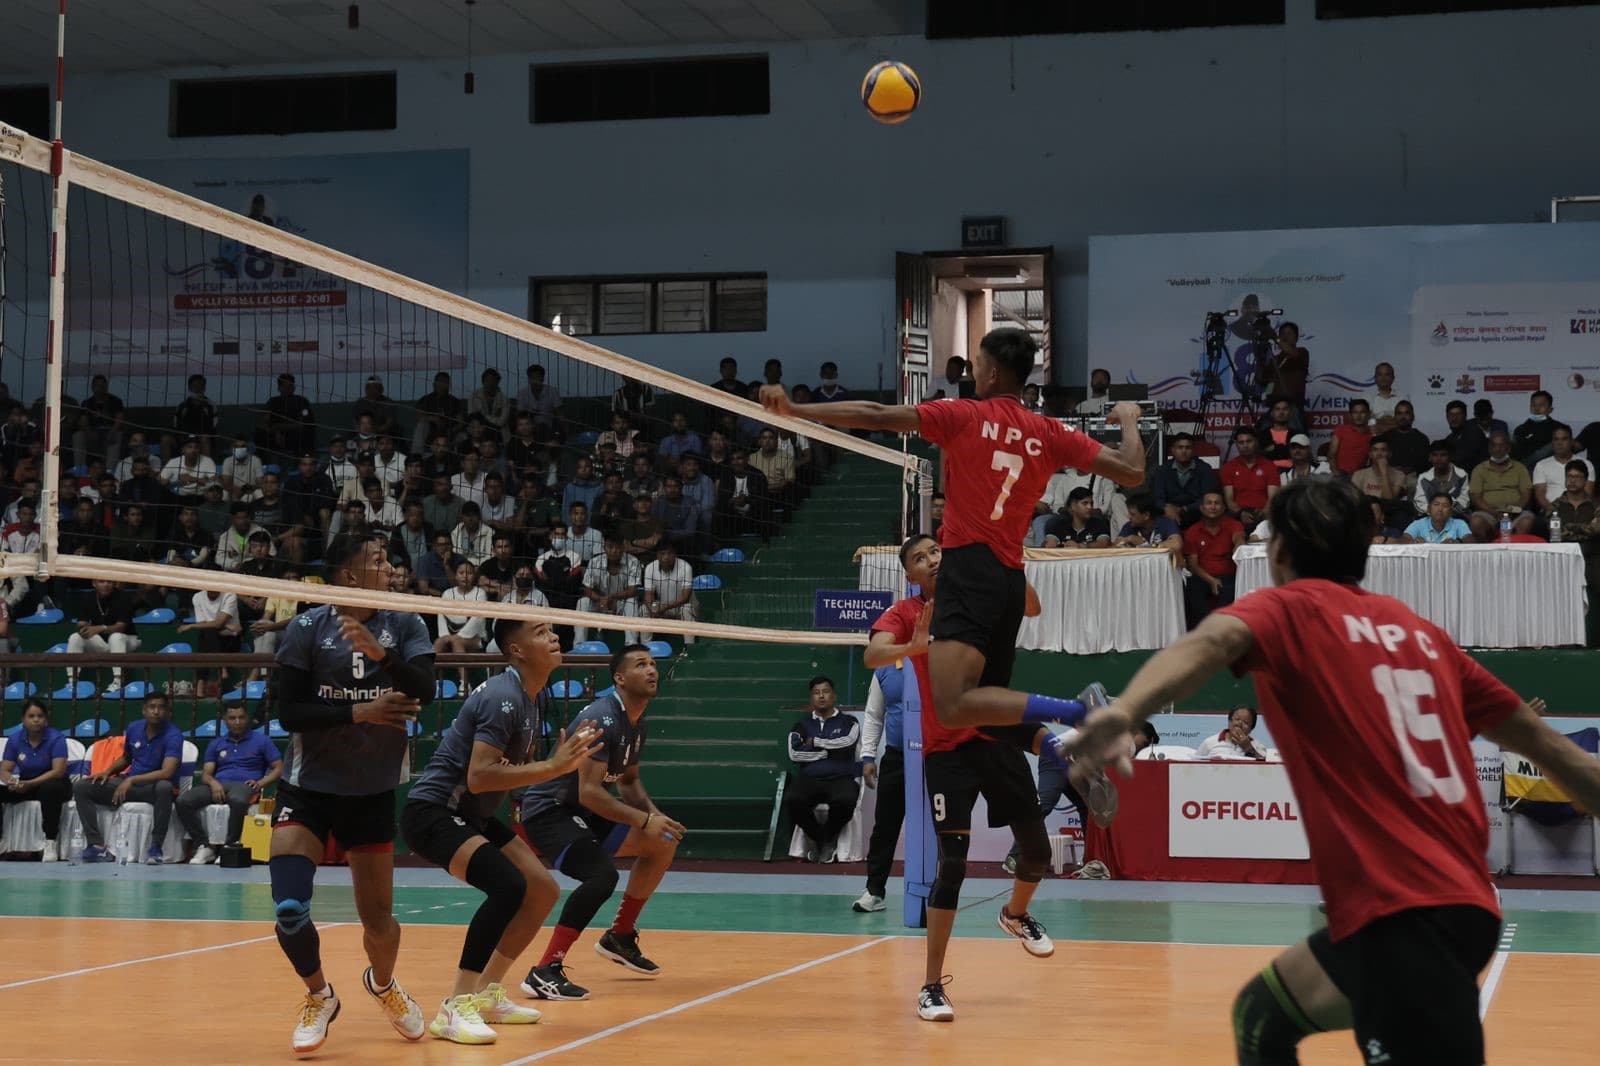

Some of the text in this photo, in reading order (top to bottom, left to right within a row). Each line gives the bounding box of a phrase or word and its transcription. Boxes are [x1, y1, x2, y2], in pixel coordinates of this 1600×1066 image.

[967, 224, 998, 241] EXIT
[1312, 415, 1344, 426] 2081
[990, 450, 1024, 521] 7
[823, 598, 885, 610] TECHNICAL
[838, 609, 868, 620] AREA
[351, 651, 365, 680] 5
[1370, 663, 1467, 805] 15
[934, 793, 945, 821] 9
[1181, 800, 1299, 822] OFFICIAL
